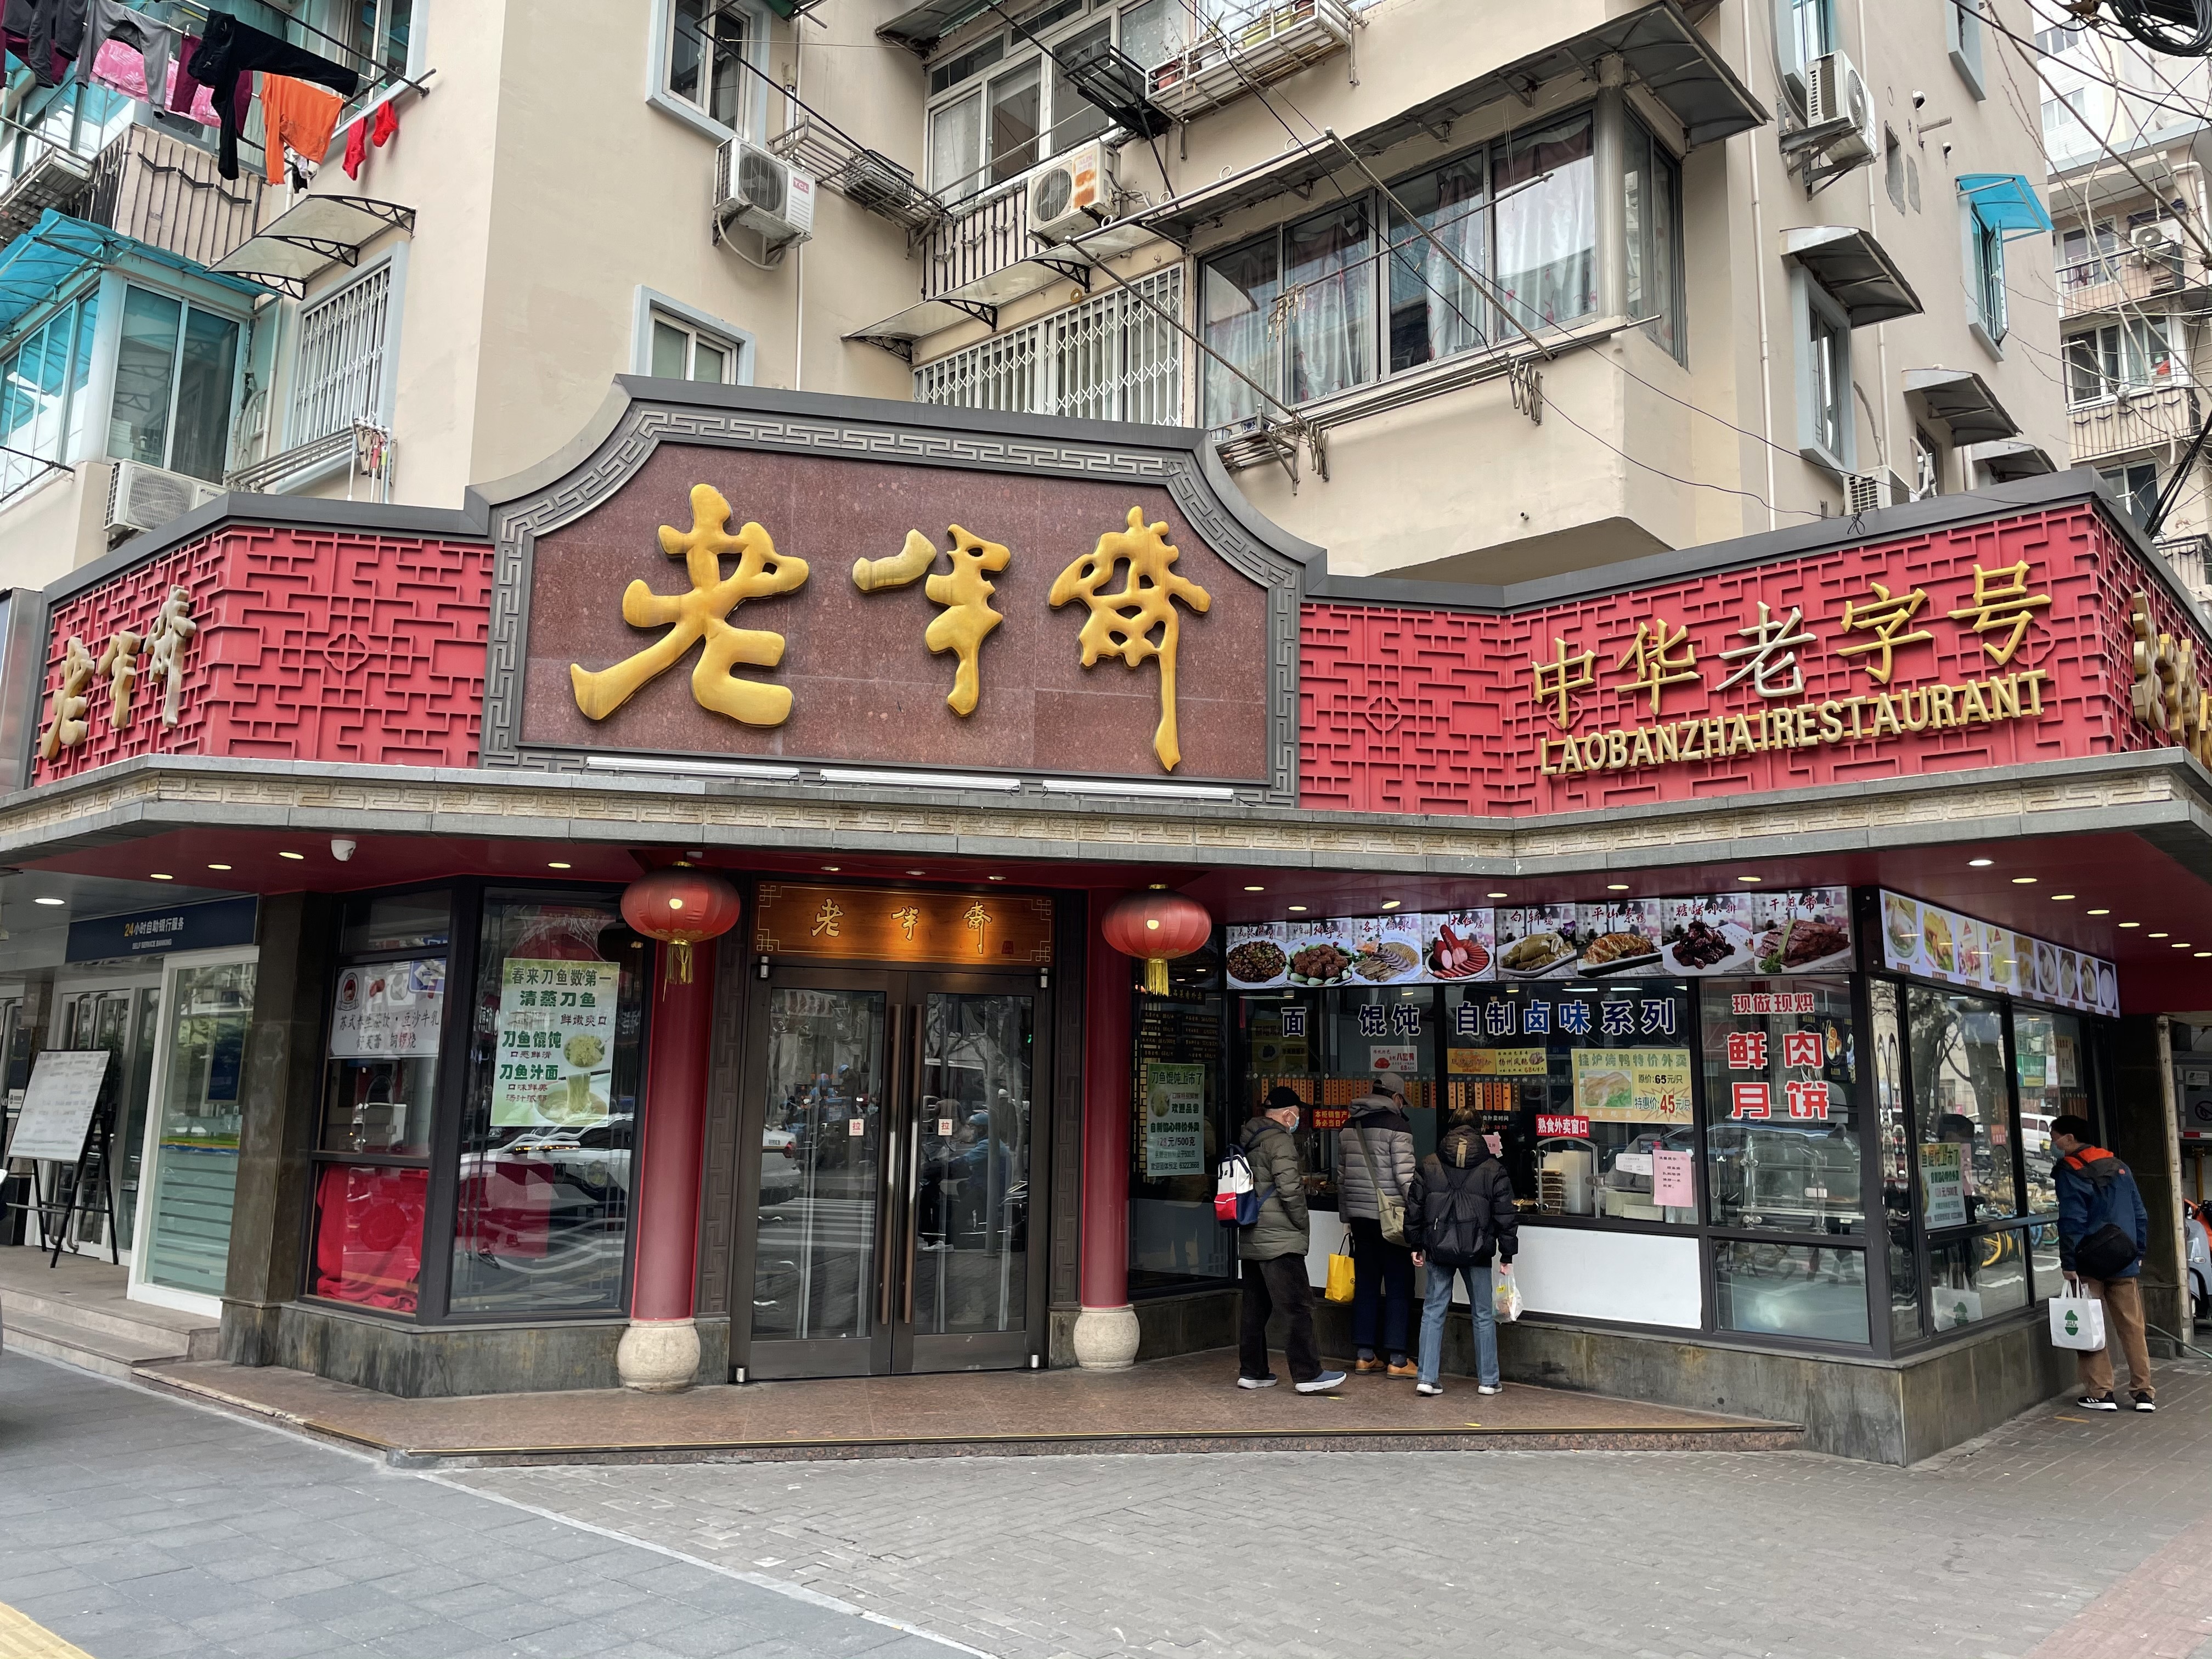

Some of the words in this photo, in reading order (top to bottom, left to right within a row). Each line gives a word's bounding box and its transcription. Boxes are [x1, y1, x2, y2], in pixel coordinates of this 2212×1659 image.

[794, 179, 809, 192] TCL
[1532, 560, 2051, 729] 中华老字号
[1676, 903, 1737, 917] 糖醋小排
[1510, 911, 1553, 926] 白斩鸡
[512, 967, 611, 986] 春来刀鱼数第一
[520, 990, 595, 1007] 清蒸刀鱼
[1732, 992, 1815, 1014] 现做现烘
[560, 1014, 607, 1026] 鲜嫩爽口
[1281, 1007, 1307, 1037] 面
[1358, 1003, 1421, 1036] 馄饨
[1456, 997, 1677, 1035] 自制卤味系列
[502, 1031, 562, 1048] 刀鱼馄饨
[1728, 1030, 1824, 1069] 鲜肉
[1578, 1053, 1687, 1067] 挂炉烤鸭特价外卖
[499, 1064, 558, 1080] 刀鱼汁面
[1152, 1072, 1202, 1085] 刀鱼馄饨上市了
[1638, 1074, 1683, 1084] 原价:65元/只
[1635, 1094, 1691, 1113] 特惠价:45元/只
[1731, 1080, 1830, 1120] 月饼
[1172, 1103, 1199, 1114] 欢迎品尝
[853, 1122, 861, 1130] 拉
[941, 1121, 950, 1130] 拉
[1538, 1117, 1587, 1134] 熟食外卖窗口
